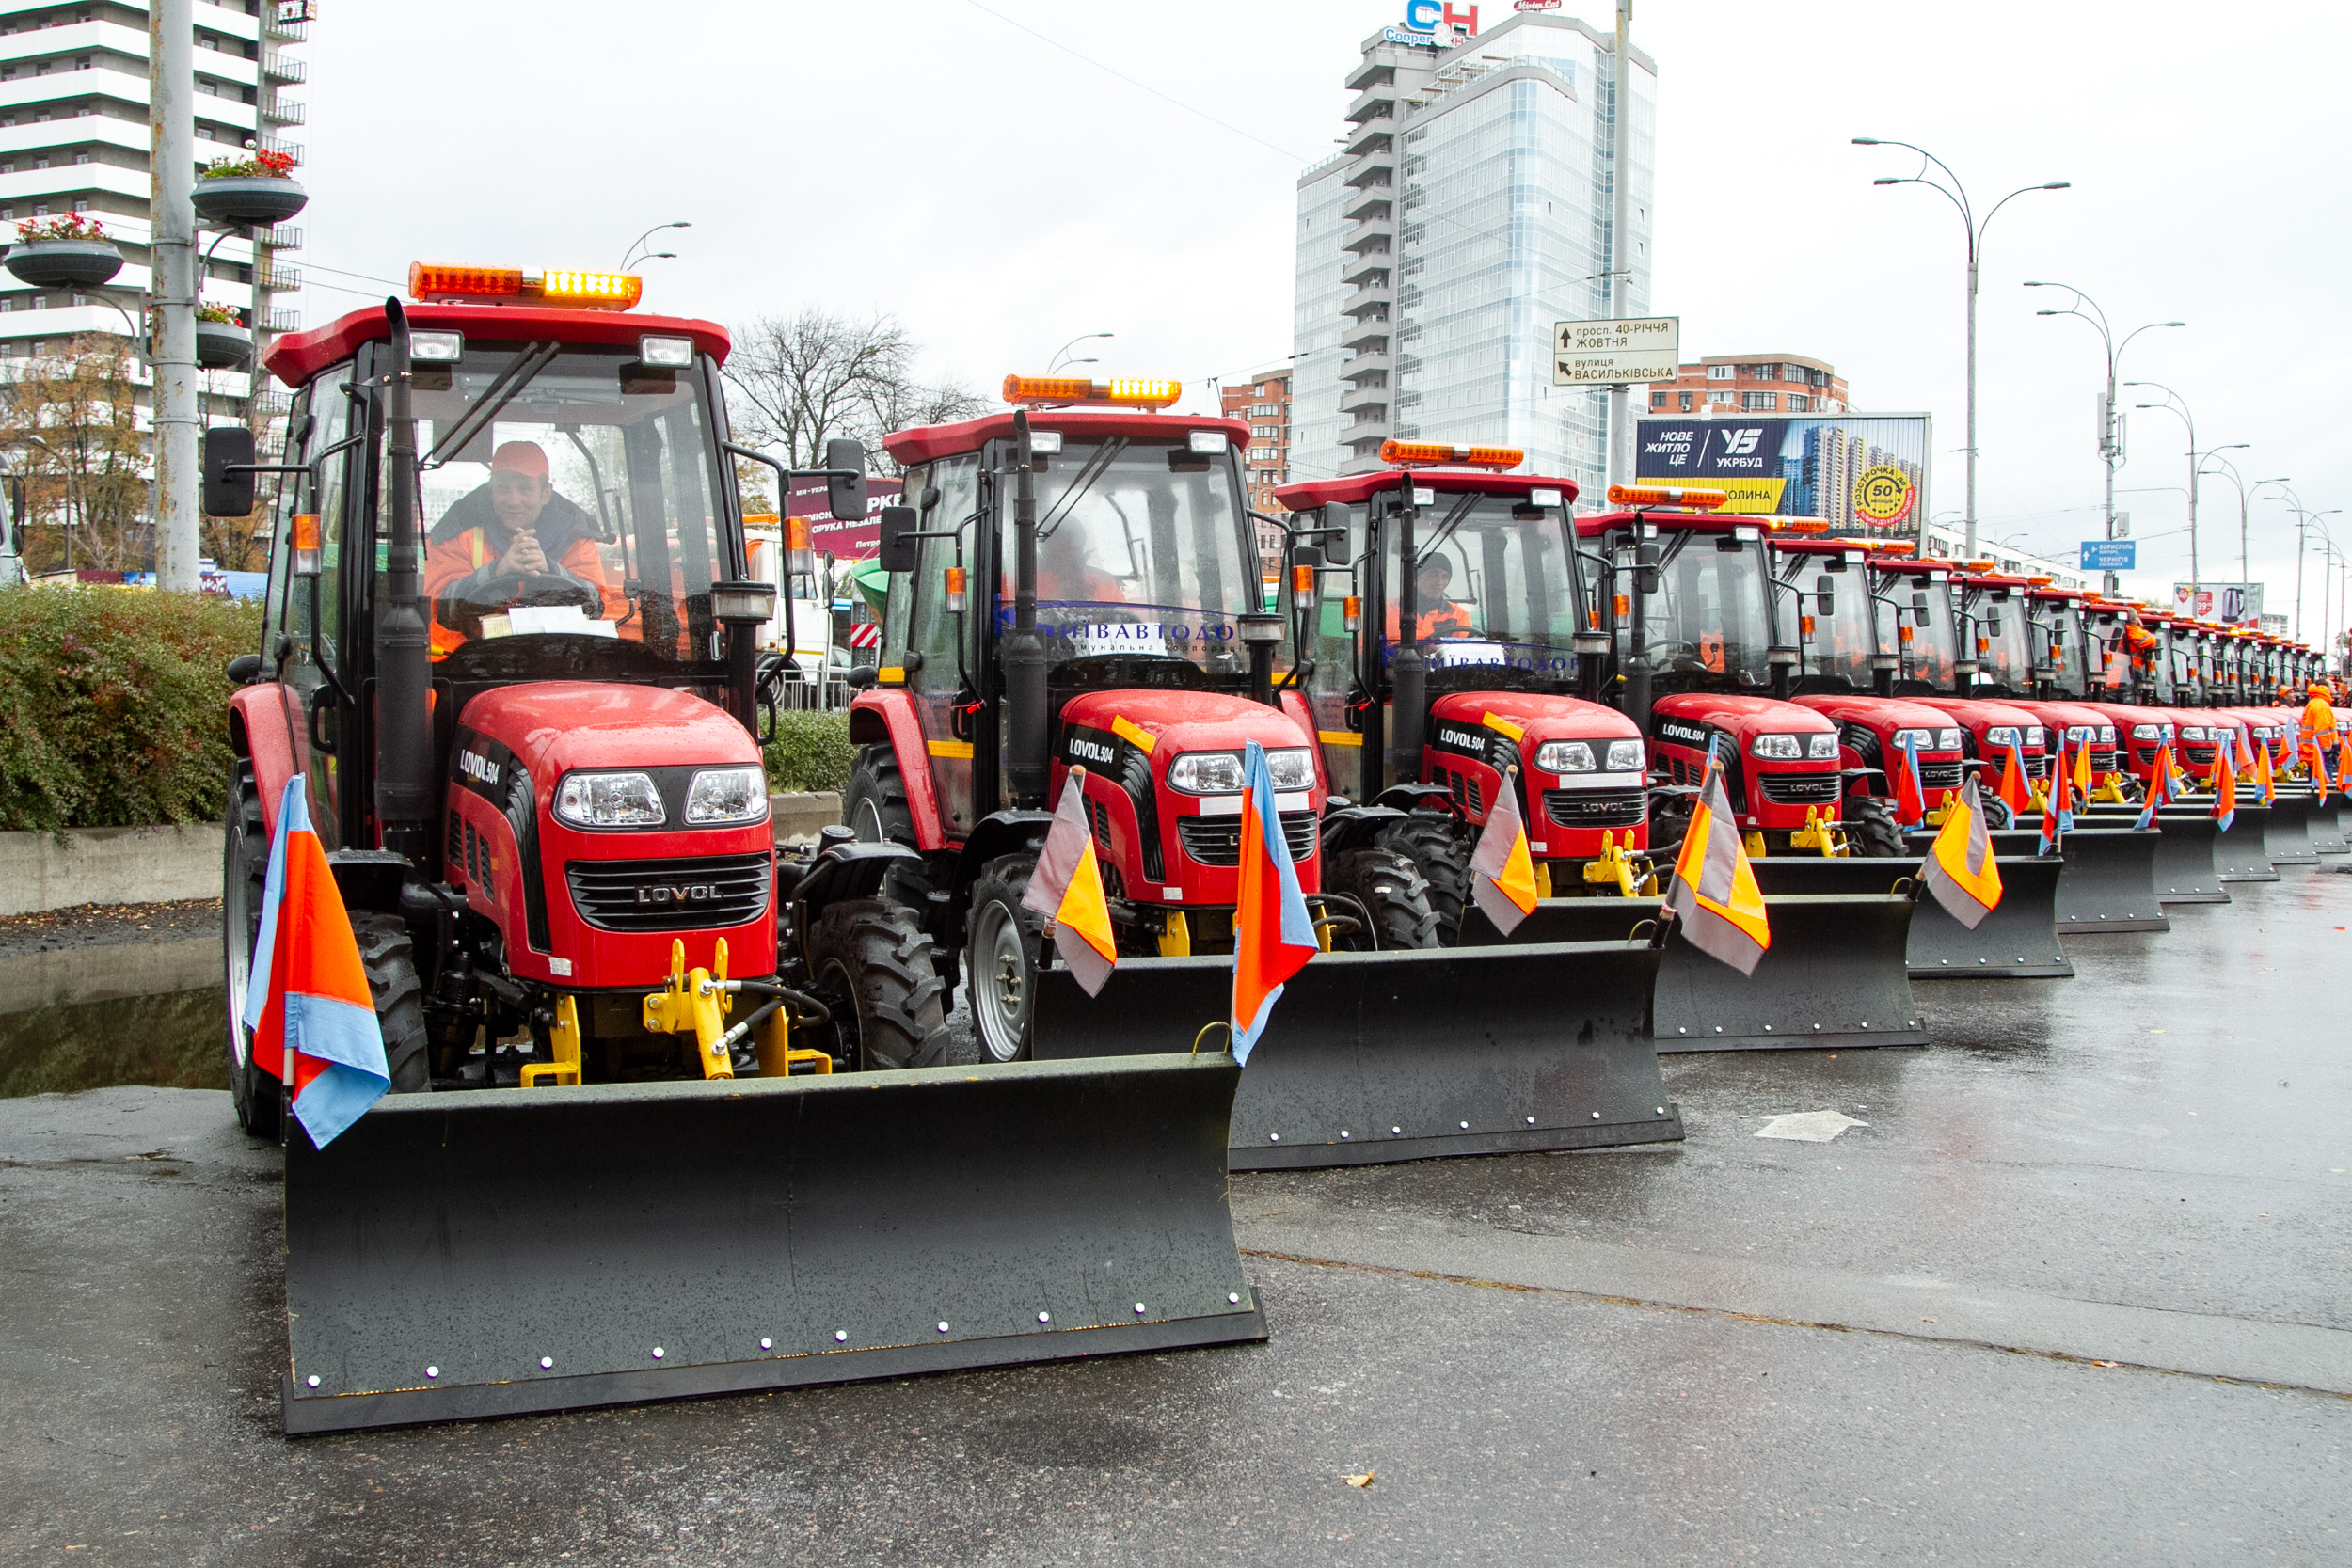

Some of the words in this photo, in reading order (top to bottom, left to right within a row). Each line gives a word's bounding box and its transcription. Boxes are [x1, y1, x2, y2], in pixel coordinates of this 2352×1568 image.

[1386, 29, 1433, 45] Cooper
[1576, 327, 1612, 338] просп.
[1615, 323, 1668, 334] 40-РІЧЧЯ
[1576, 337, 1628, 348] ЖОВТНЯ
[1575, 359, 1613, 369] вулиця
[1574, 367, 1674, 380] ВАСИЛЬКІВСЬКА
[1660, 432, 1694, 441] НОВЕ
[1644, 443, 1691, 452] ЖИТЛО
[1669, 454, 1688, 467] ЦЕ
[1716, 457, 1763, 467] УКРБУД
[796, 485, 828, 497] МИ-УКРА
[1854, 467, 1895, 506] РОЗСТРОЧКА
[1872, 485, 1893, 497] 50
[1725, 489, 1771, 500] ОЛИНА
[812, 522, 843, 534] ОРУКА
[845, 515, 882, 529] НЕЗАЛЕ
[1790, 784, 1825, 792] LOVOL
[1582, 802, 1626, 813] LOVOL
[638, 885, 723, 903] LOVOL
